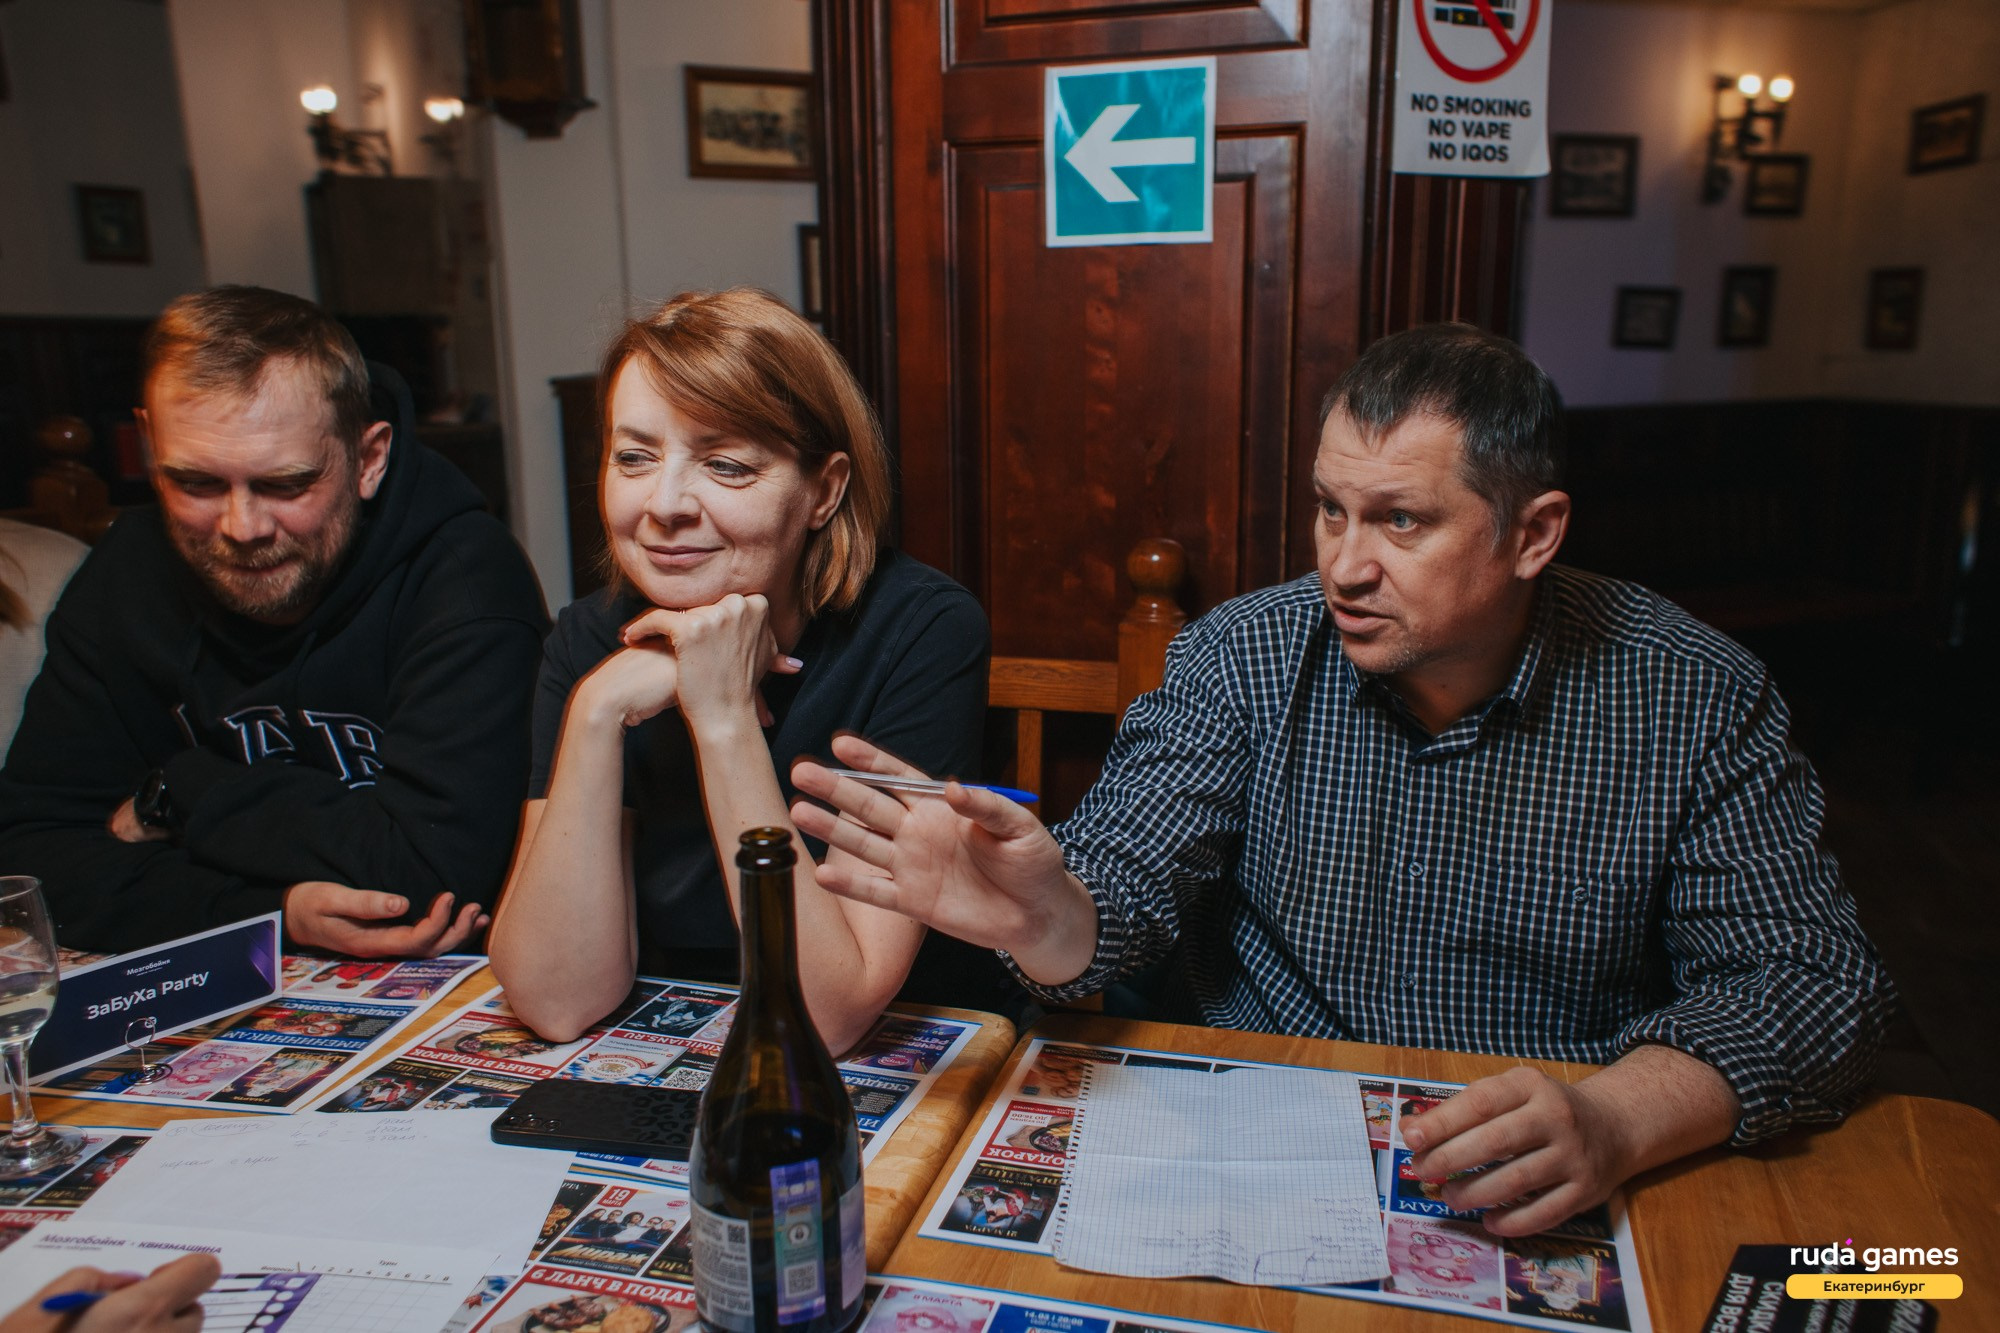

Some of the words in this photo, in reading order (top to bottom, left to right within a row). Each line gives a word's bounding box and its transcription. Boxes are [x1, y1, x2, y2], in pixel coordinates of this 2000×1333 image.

[1411, 93, 1438, 112] NO
[1444, 95, 1532, 118] SMOKING
[1428, 119, 1457, 137] NO
[1462, 121, 1511, 140] VAPE
[1428, 142, 1457, 161] NO
[1462, 144, 1509, 162] IQOS
[126, 958, 171, 976] Мозгобойня
[86, 988, 157, 1020] ЗаБуХа
[161, 971, 210, 995] Party
[411, 1048, 482, 1067] ПОДАРОК
[496, 1061, 539, 1074] ЛАНЧ
[601, 1198, 623, 1207] МАРТА
[610, 1188, 630, 1200] 19
[40, 1234, 126, 1247] Мозгобойня
[138, 1240, 223, 1255] КВИЗМАШИНА
[531, 1268, 545, 1280] 6
[549, 1271, 607, 1290] ЛАНЧ
[608, 1279, 623, 1292] В
[1723, 1272, 1755, 1304] ДЛЯ
